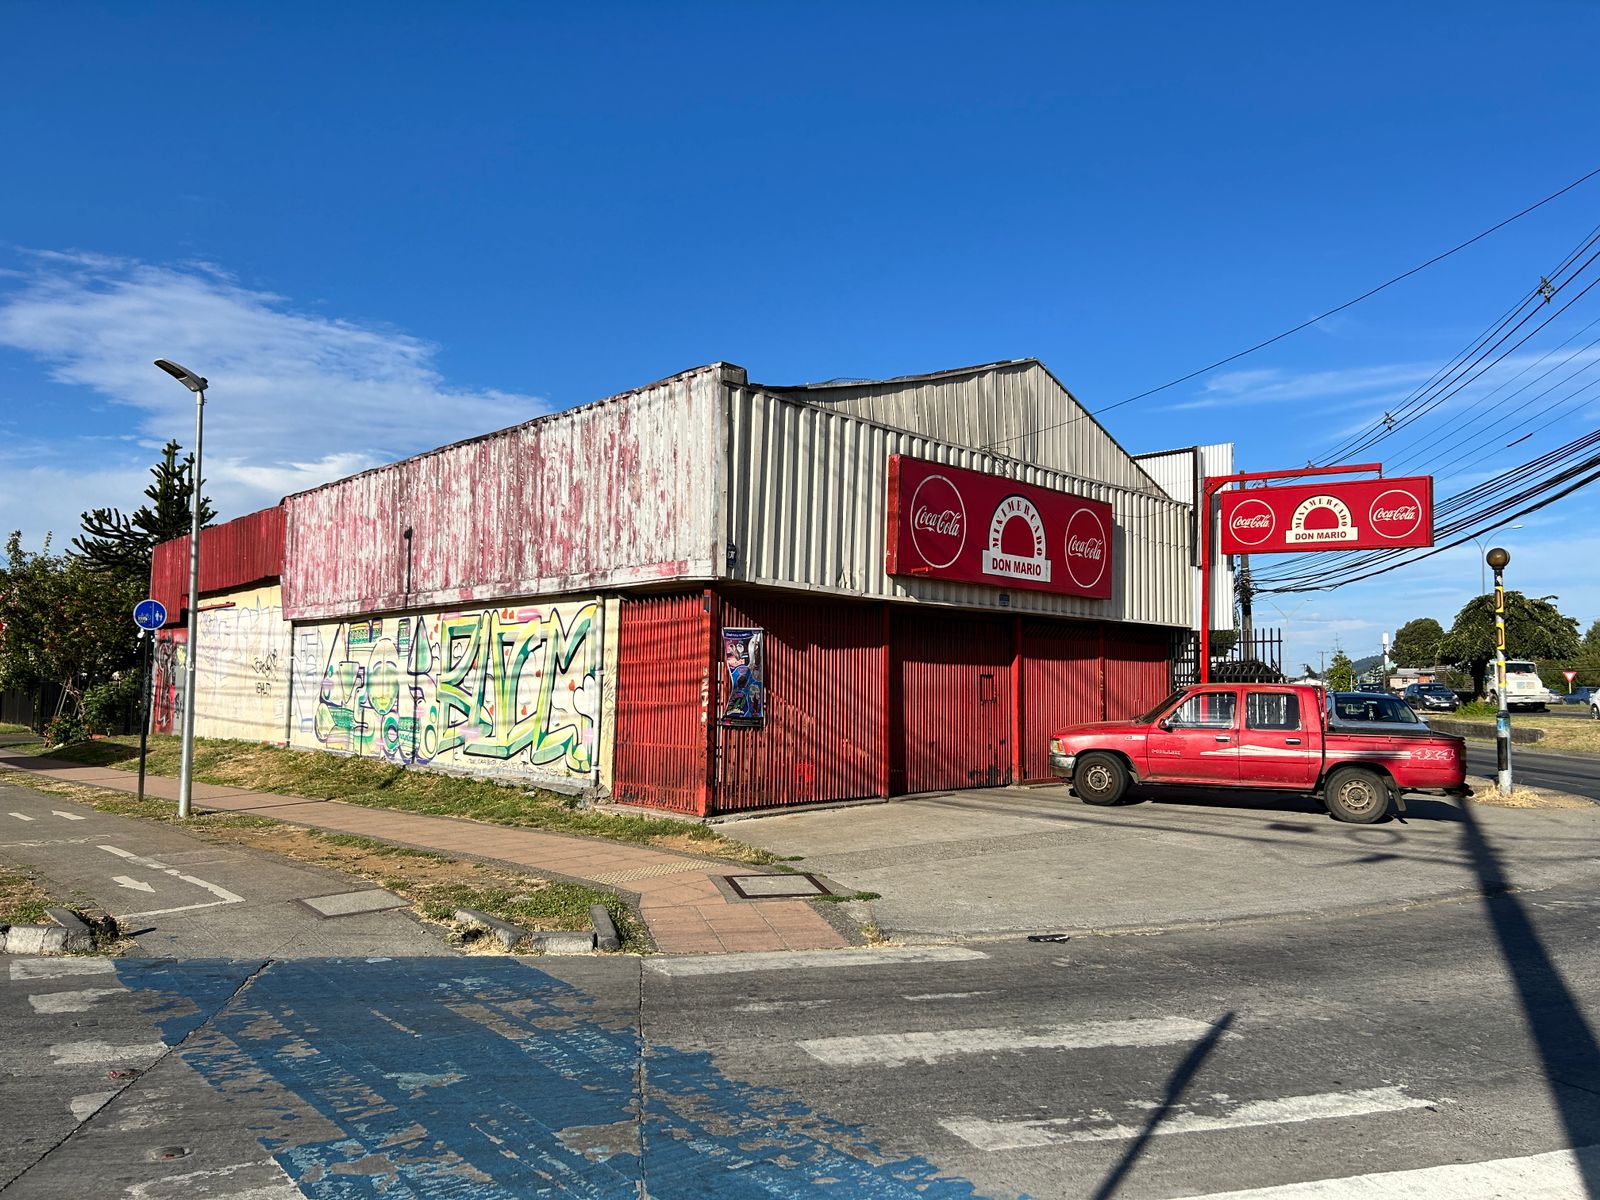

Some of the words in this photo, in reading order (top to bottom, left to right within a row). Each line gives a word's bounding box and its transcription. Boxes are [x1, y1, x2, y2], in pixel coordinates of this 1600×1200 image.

[914, 505, 962, 536] Coca-Cola
[993, 500, 1043, 556] MINIMERCADO
[1295, 498, 1348, 529] MINIMERCADO
[1316, 531, 1347, 539] MARIO
[992, 558, 1011, 573] DON
[1013, 560, 1042, 576] MARIO
